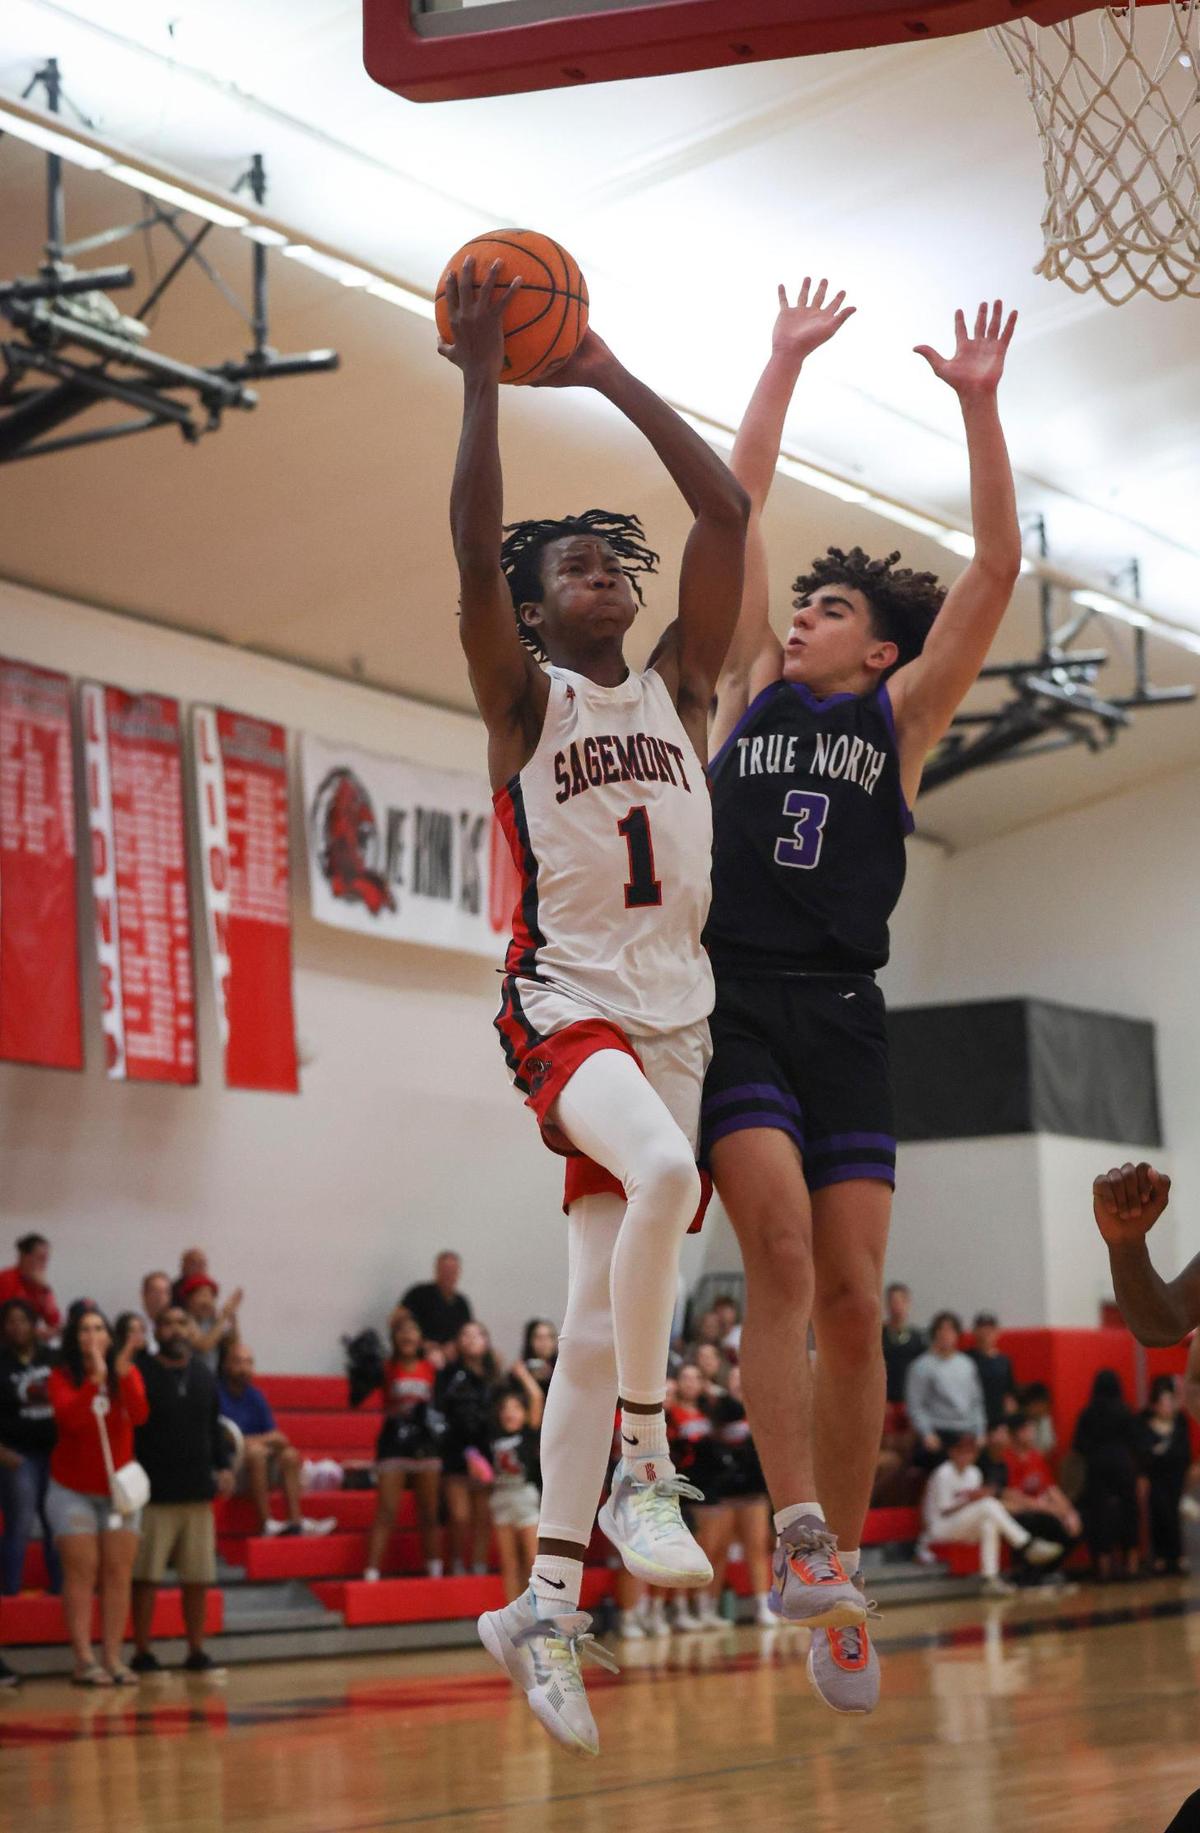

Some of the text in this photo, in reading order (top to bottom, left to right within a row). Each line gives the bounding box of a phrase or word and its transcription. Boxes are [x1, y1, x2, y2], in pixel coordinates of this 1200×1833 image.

[554, 732, 691, 805] SAGEMONT
[737, 732, 887, 796] TRUE NORTH
[617, 805, 663, 909] 1
[774, 789, 830, 870] 3
